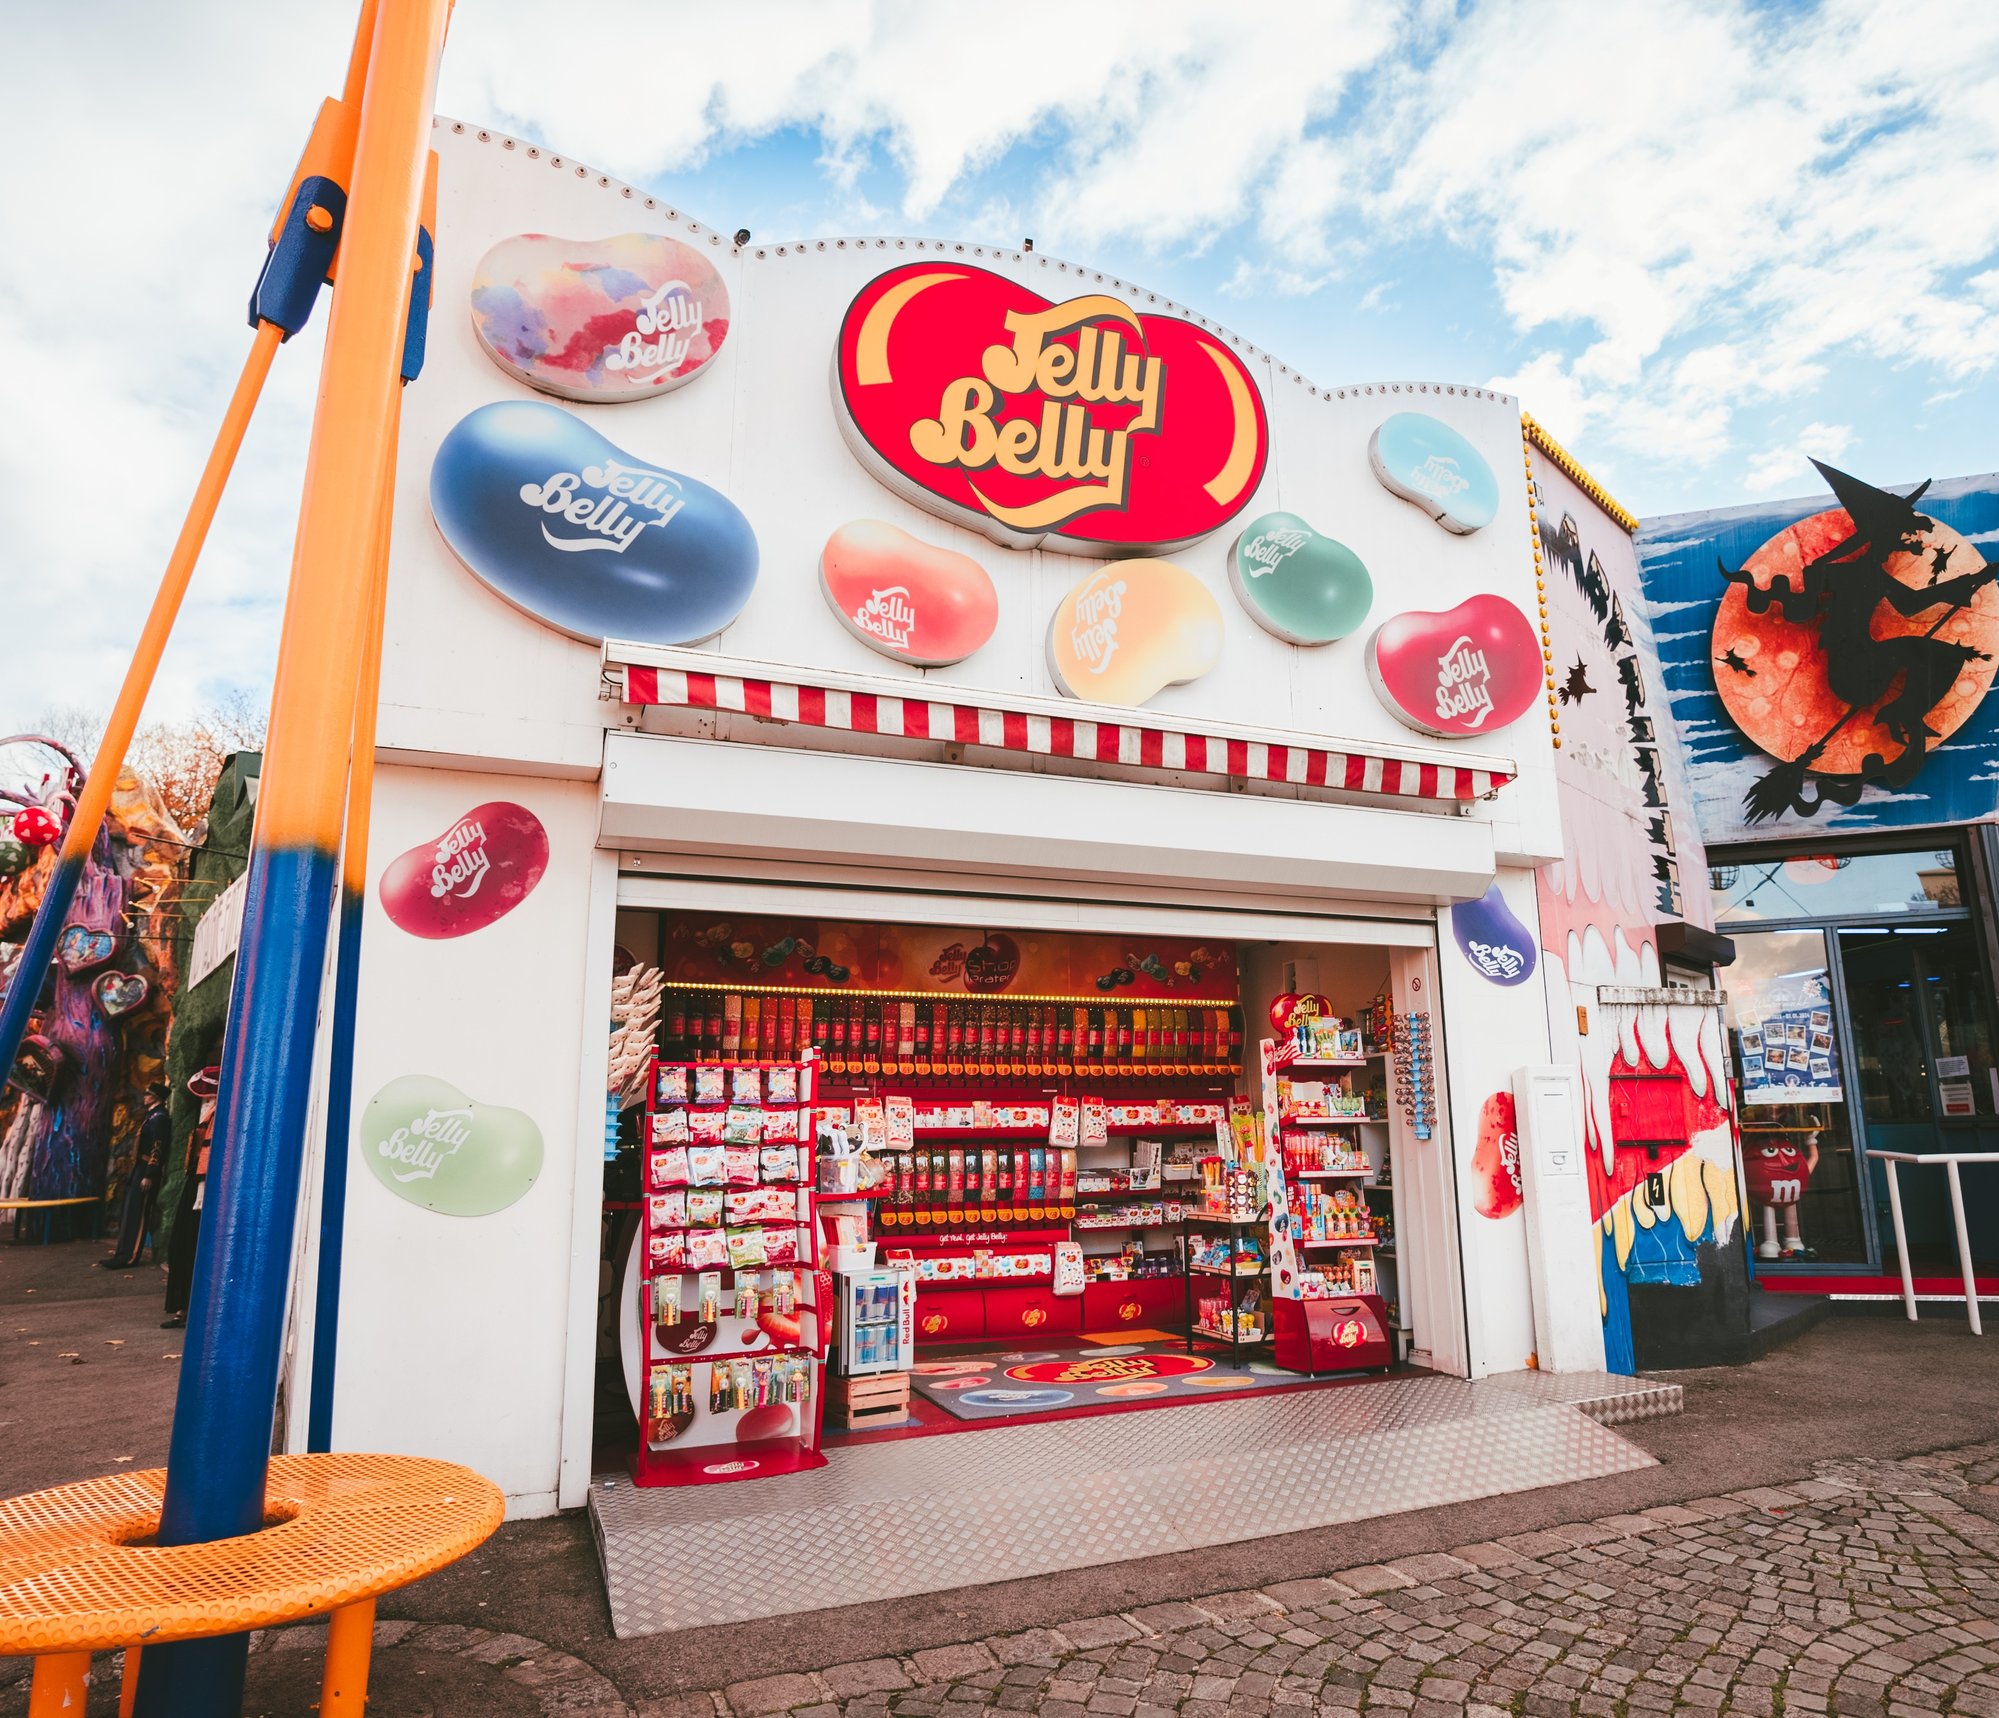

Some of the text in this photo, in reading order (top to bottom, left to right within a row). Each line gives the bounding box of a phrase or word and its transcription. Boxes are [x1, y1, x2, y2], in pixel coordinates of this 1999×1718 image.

[636, 280, 702, 336] Jelly
[605, 331, 690, 384] Belly
[981, 294, 1164, 434] Jelly
[908, 375, 1131, 529] Belly
[520, 472, 647, 554] Belly
[582, 459, 686, 528] Jelly
[1244, 535, 1283, 578] Belly
[1266, 528, 1312, 557] Jelly
[865, 586, 915, 632] Jelly
[1076, 573, 1127, 625] Belly
[852, 607, 909, 649] Belly
[1072, 618, 1121, 675] Jelly
[1437, 635, 1491, 687] Jelly
[1435, 682, 1495, 728] Belly
[435, 818, 487, 864] Jelly
[430, 846, 491, 898] Belly
[1468, 940, 1502, 977] Belly
[1491, 944, 1524, 979] Jelly
[1284, 1013, 1311, 1028] Bell
[1293, 994, 1320, 1017] Jelly
[410, 1108, 474, 1154] Jelly
[378, 1127, 444, 1183] Belly
[1770, 1179, 1801, 1203] m
[689, 1325, 708, 1342] Jelly
[902, 1308, 910, 1345] Red Bull
[1067, 1357, 1155, 1372] Jelly
